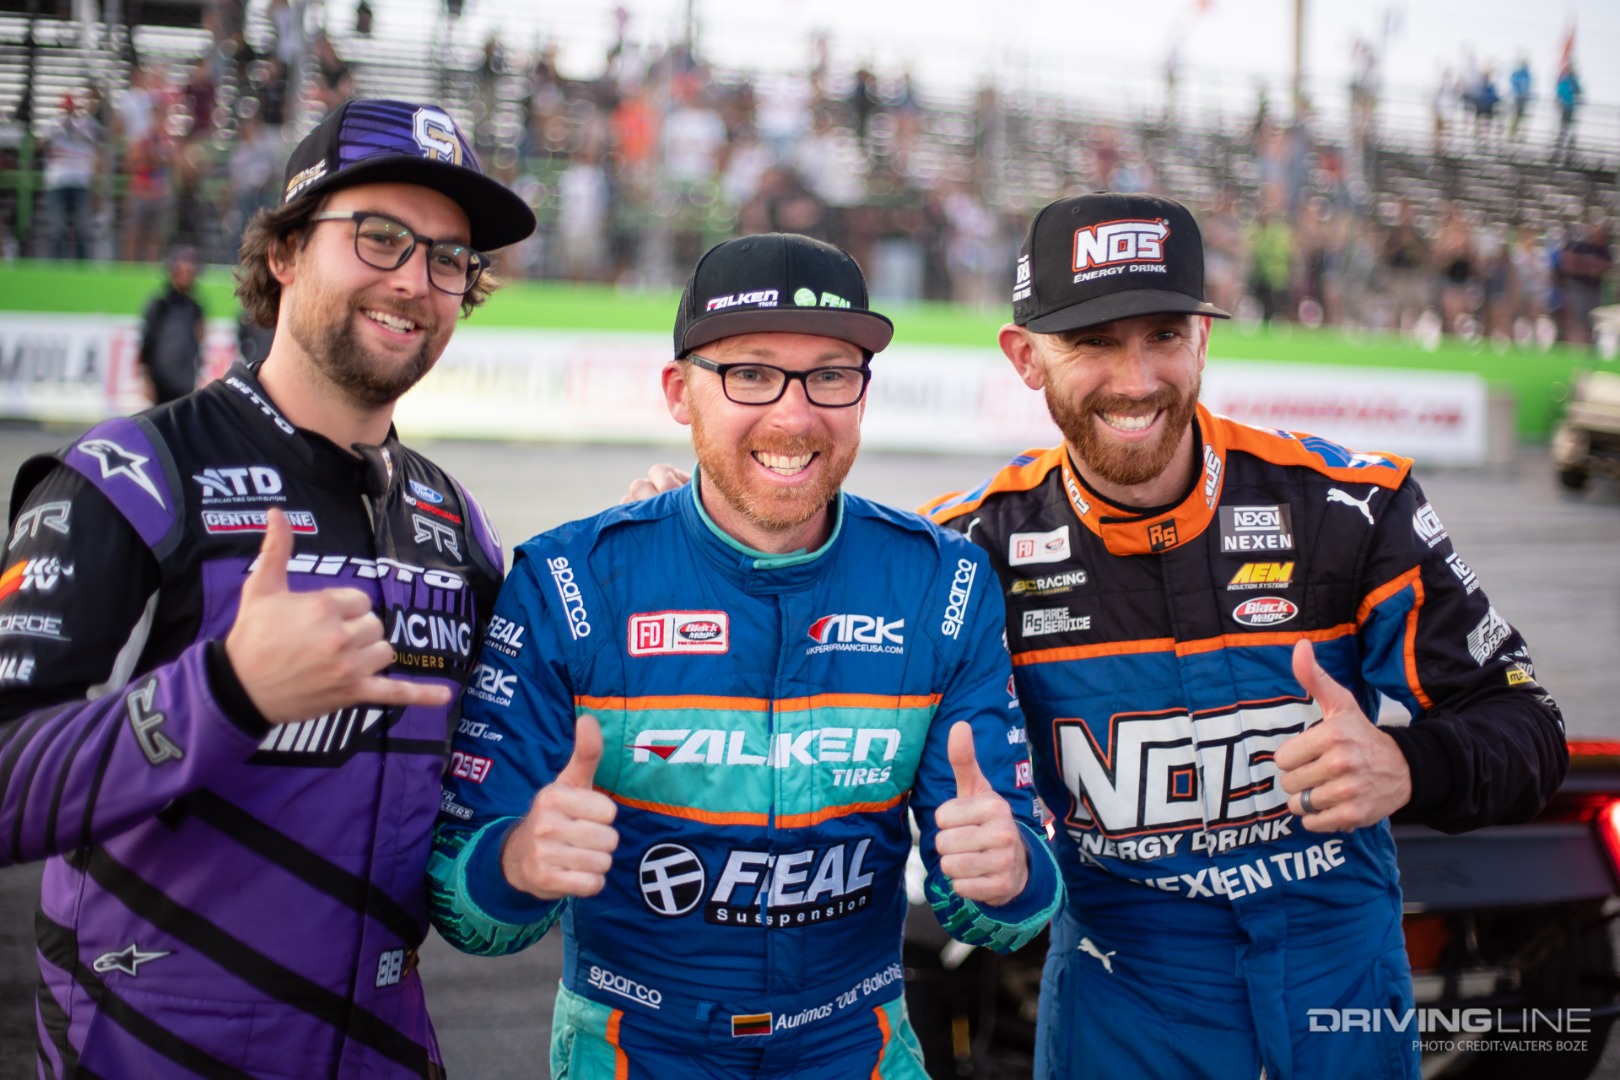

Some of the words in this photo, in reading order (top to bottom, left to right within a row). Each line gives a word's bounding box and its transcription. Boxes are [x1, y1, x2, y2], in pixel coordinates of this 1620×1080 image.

[1074, 220, 1169, 270] NOS
[1074, 266, 1126, 284] ENERGY
[1129, 263, 1167, 274] DRINK
[706, 289, 779, 312] FALKEN
[192, 466, 283, 497] ATD
[1234, 511, 1280, 527] NEXEN
[1150, 524, 1177, 548] RS
[1224, 533, 1292, 551] NEXEN
[1227, 583, 1258, 591] INDUCTION
[1258, 581, 1289, 589] SYSTEMS
[1228, 561, 1295, 584] AEM
[549, 556, 591, 639] sparco
[942, 557, 974, 637] sparco
[1244, 600, 1289, 614] Black
[1044, 607, 1070, 620] RACE
[1044, 615, 1091, 634] SERVICE
[1250, 612, 1286, 624] Magic
[384, 609, 472, 657] ACING
[640, 621, 661, 648] FD
[685, 623, 719, 632] Black
[688, 631, 717, 640] Magic
[808, 613, 905, 645] ARK
[626, 728, 902, 769] FALKEN
[832, 765, 892, 787] TIRES
[1056, 699, 1323, 836] NOS
[1191, 815, 1295, 857] DRINK
[711, 838, 876, 909] FEAL
[1269, 839, 1347, 882] TIRE
[716, 894, 867, 928] Suspension
[376, 949, 404, 988] 88
[588, 965, 662, 1007] sparco
[775, 1003, 833, 1031] Aurimas
